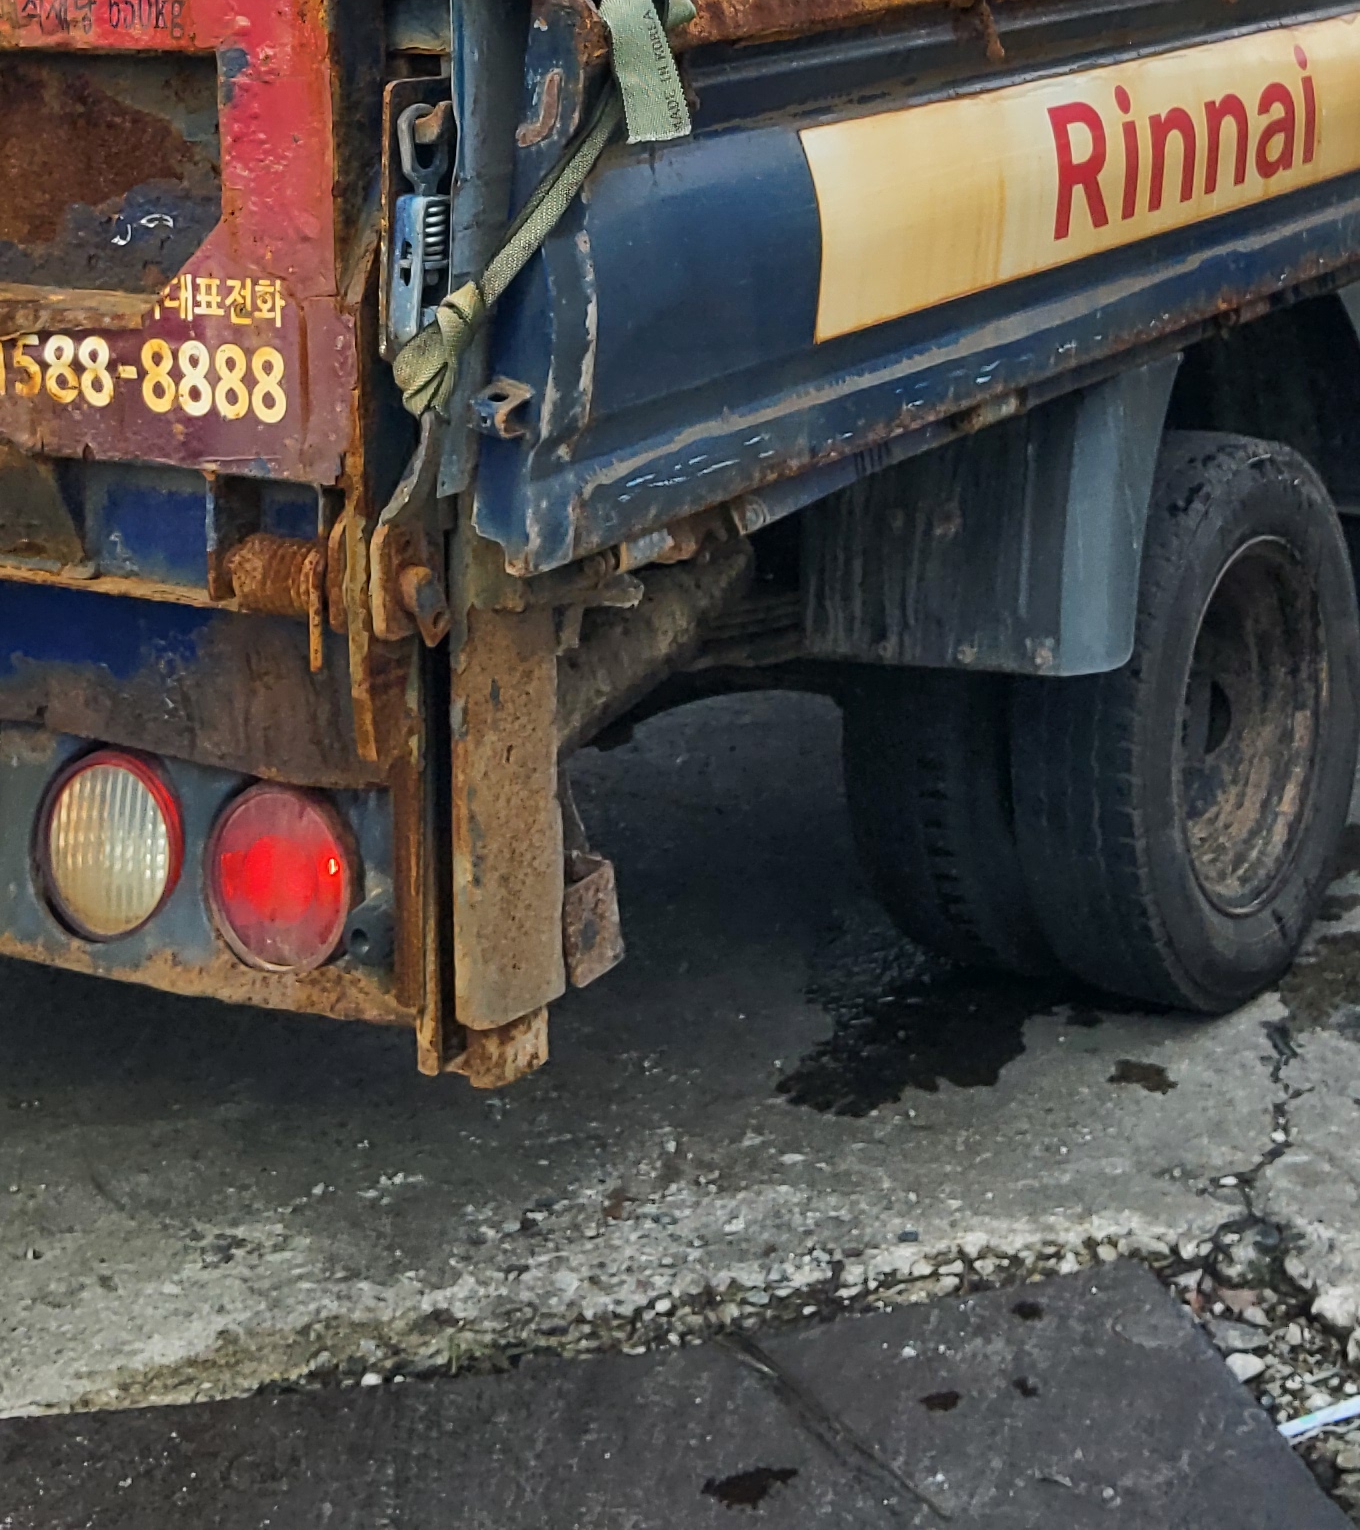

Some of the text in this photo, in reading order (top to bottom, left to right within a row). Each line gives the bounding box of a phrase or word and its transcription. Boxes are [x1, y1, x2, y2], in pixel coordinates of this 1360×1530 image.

[643, 9, 666, 60] KOREA
[1047, 43, 1316, 242] Rinnai
[163, 273, 286, 328] 대표전화
